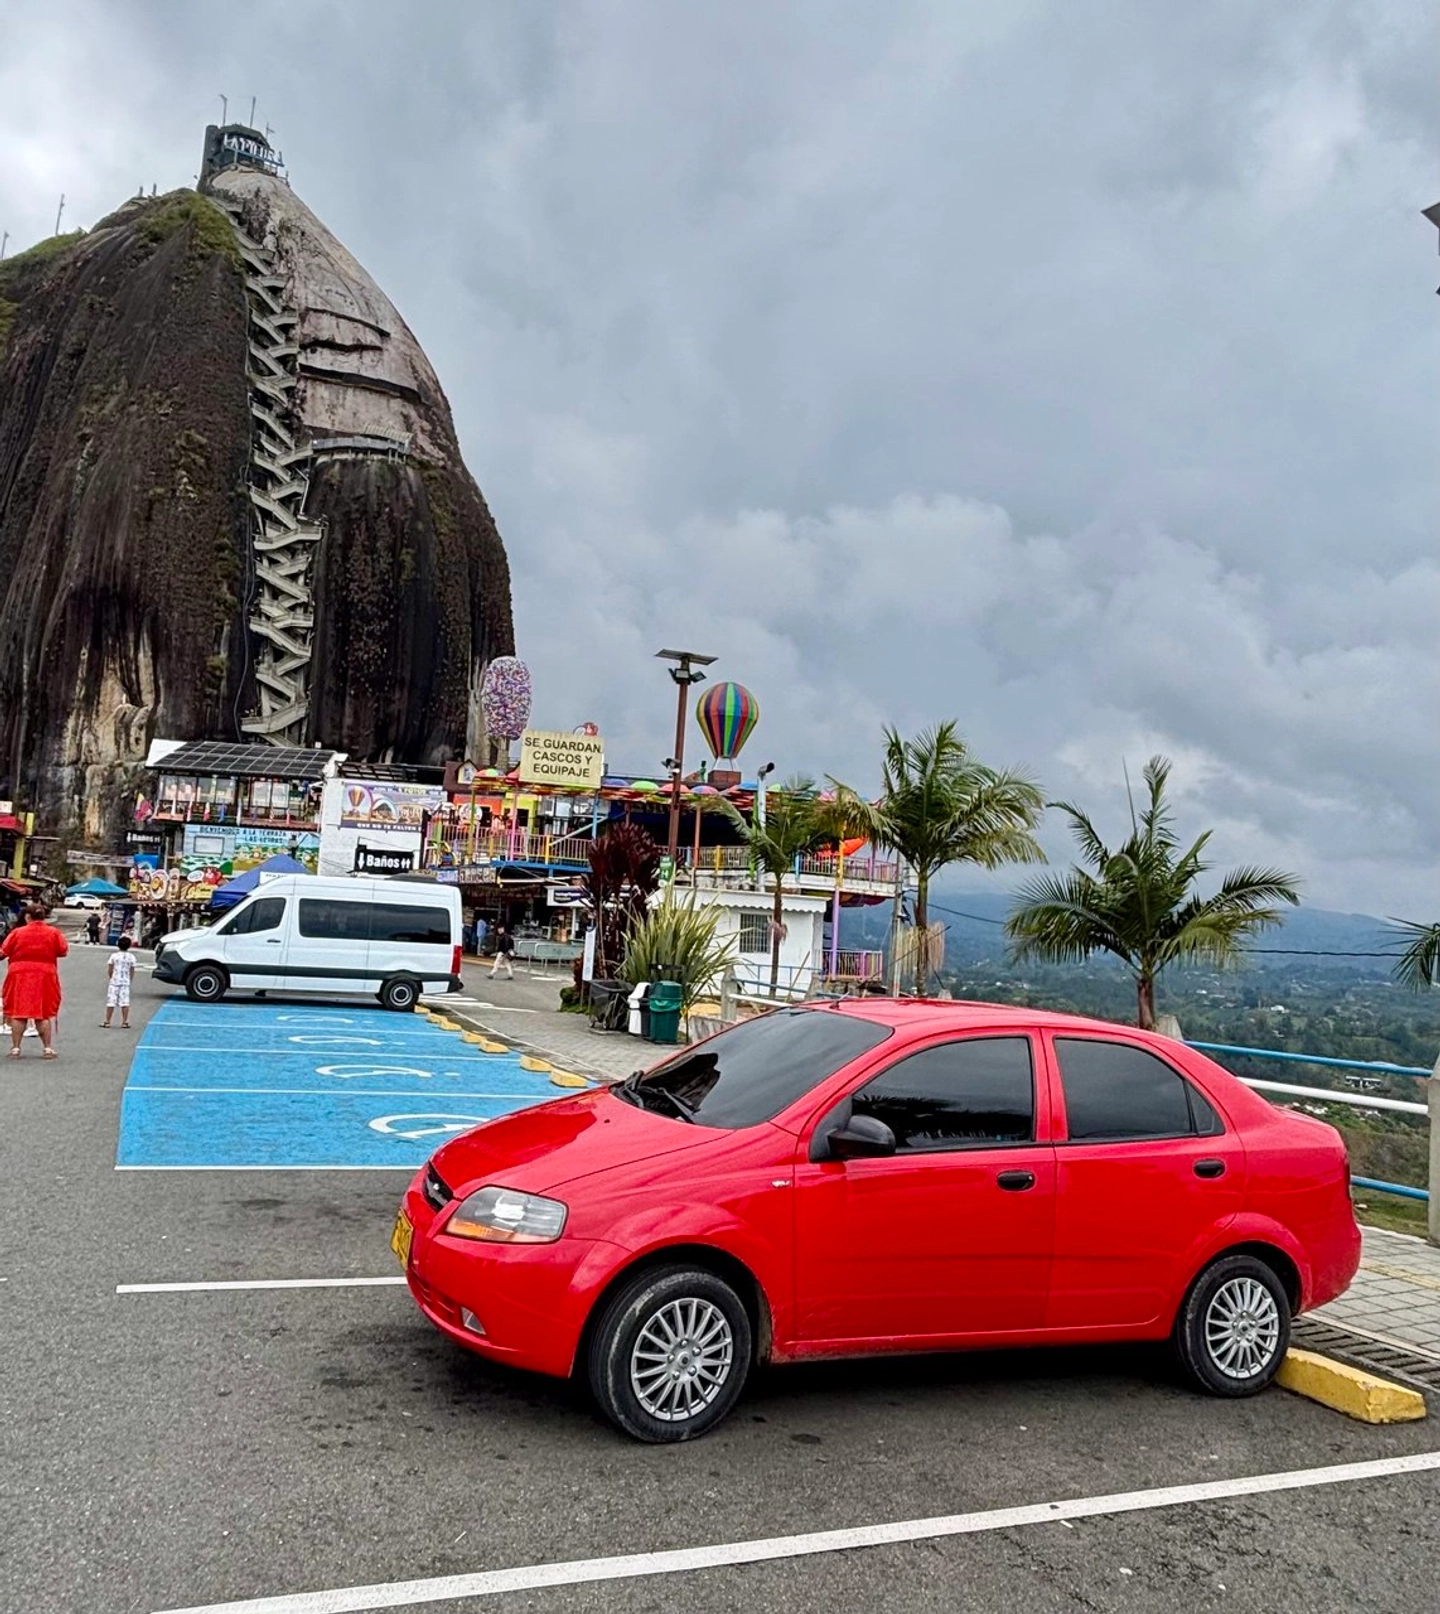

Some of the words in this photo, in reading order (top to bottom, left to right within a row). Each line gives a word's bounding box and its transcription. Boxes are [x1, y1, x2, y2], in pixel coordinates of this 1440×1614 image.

[524, 736, 541, 748] SE
[543, 738, 602, 753] GUARDAN
[532, 750, 582, 764] CASCOS
[585, 756, 593, 765] Y
[533, 763, 590, 777] EQUIPAJE
[366, 853, 400, 869] Baños
